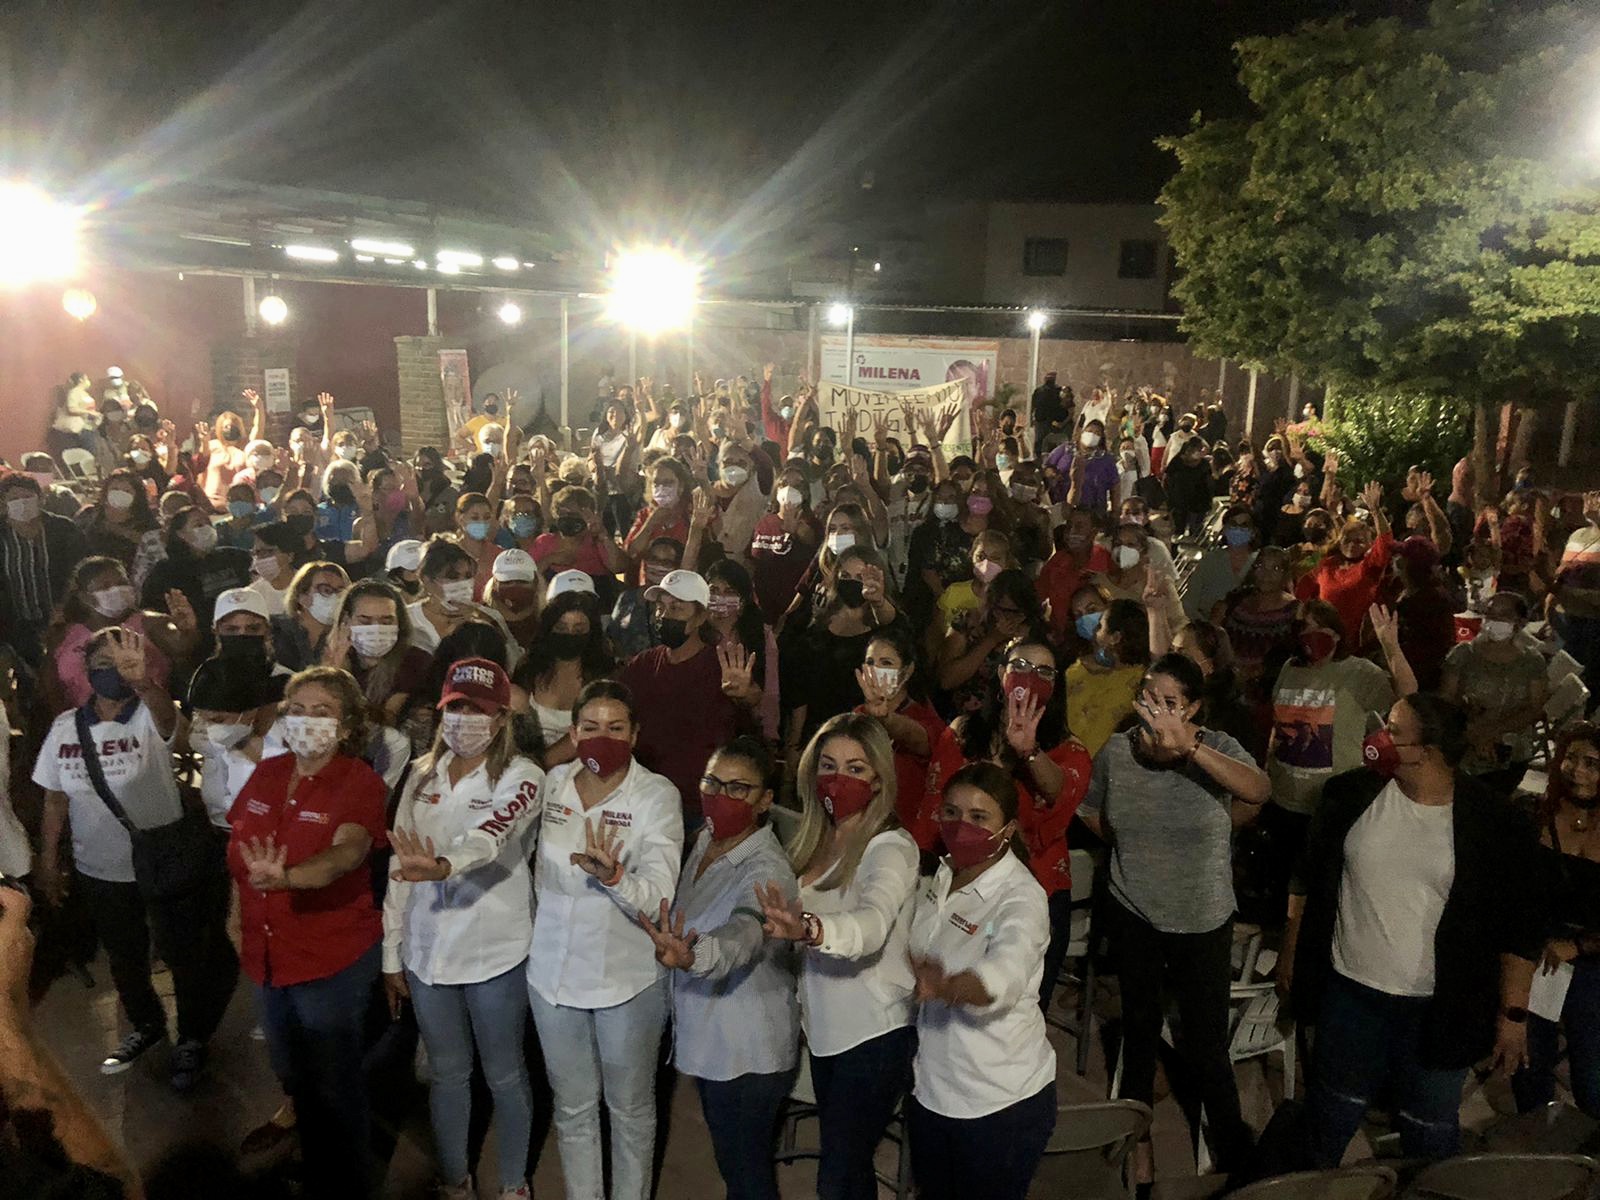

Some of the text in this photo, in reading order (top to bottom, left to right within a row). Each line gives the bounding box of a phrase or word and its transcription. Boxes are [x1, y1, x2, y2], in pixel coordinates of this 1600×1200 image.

[859, 366, 921, 381] MILENA
[58, 735, 140, 759] MENA
[478, 780, 538, 837] moena
